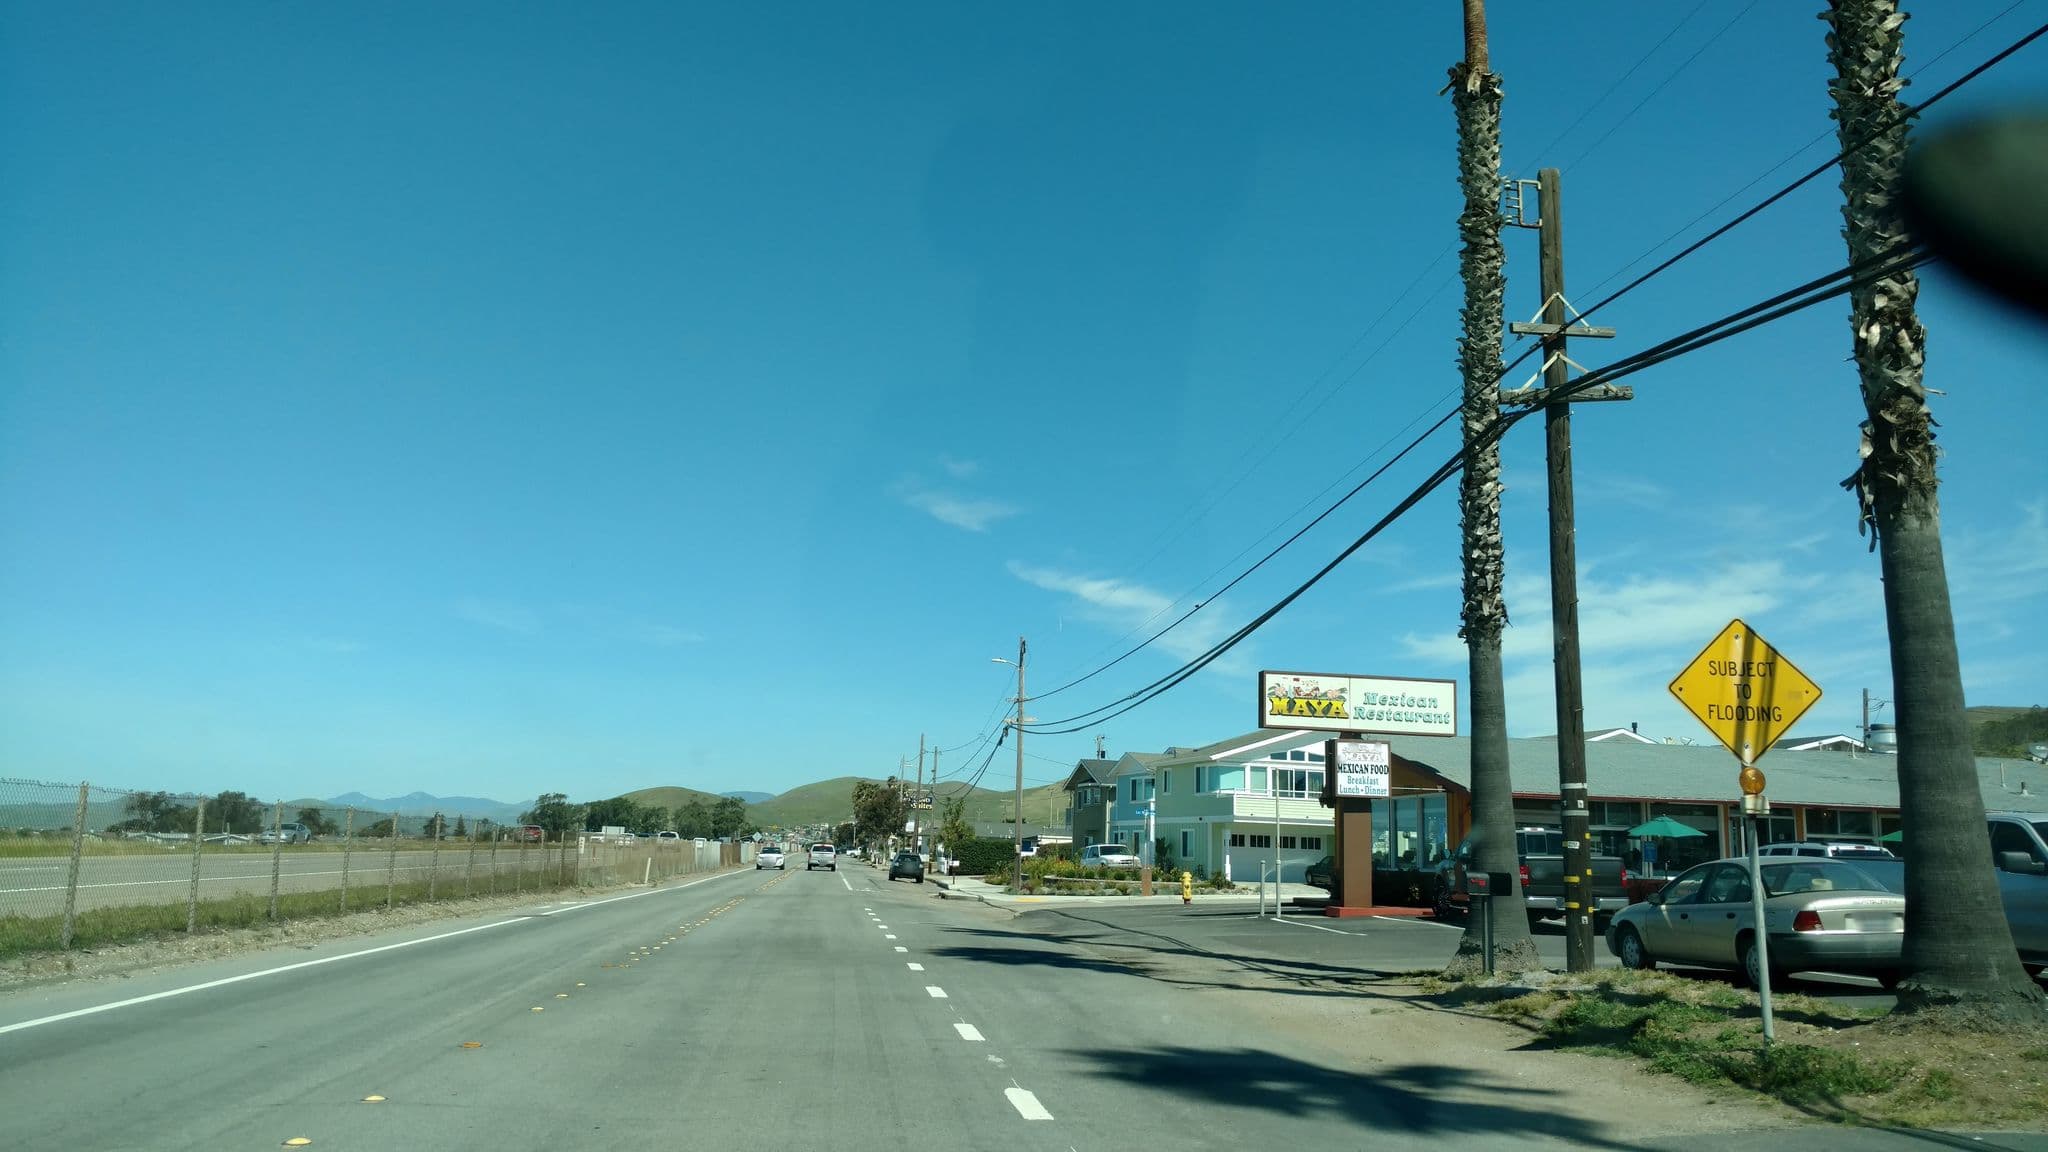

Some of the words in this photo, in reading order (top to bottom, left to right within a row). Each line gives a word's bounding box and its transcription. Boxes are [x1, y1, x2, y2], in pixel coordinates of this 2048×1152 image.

[1709, 660, 1775, 678] SUBJECT
[1734, 683, 1752, 699] TO
[1269, 696, 1349, 719] MAYA
[1363, 692, 1438, 708] Mexican
[1353, 706, 1450, 724] Restaurant
[1708, 704, 1782, 722] FLOODING
[1337, 763, 1369, 774] MEXICAN
[1370, 764, 1389, 774] FOOD
[1347, 775, 1379, 785] Breakfast
[1340, 784, 1360, 794] Lunch
[1365, 785, 1387, 795] Dinner
